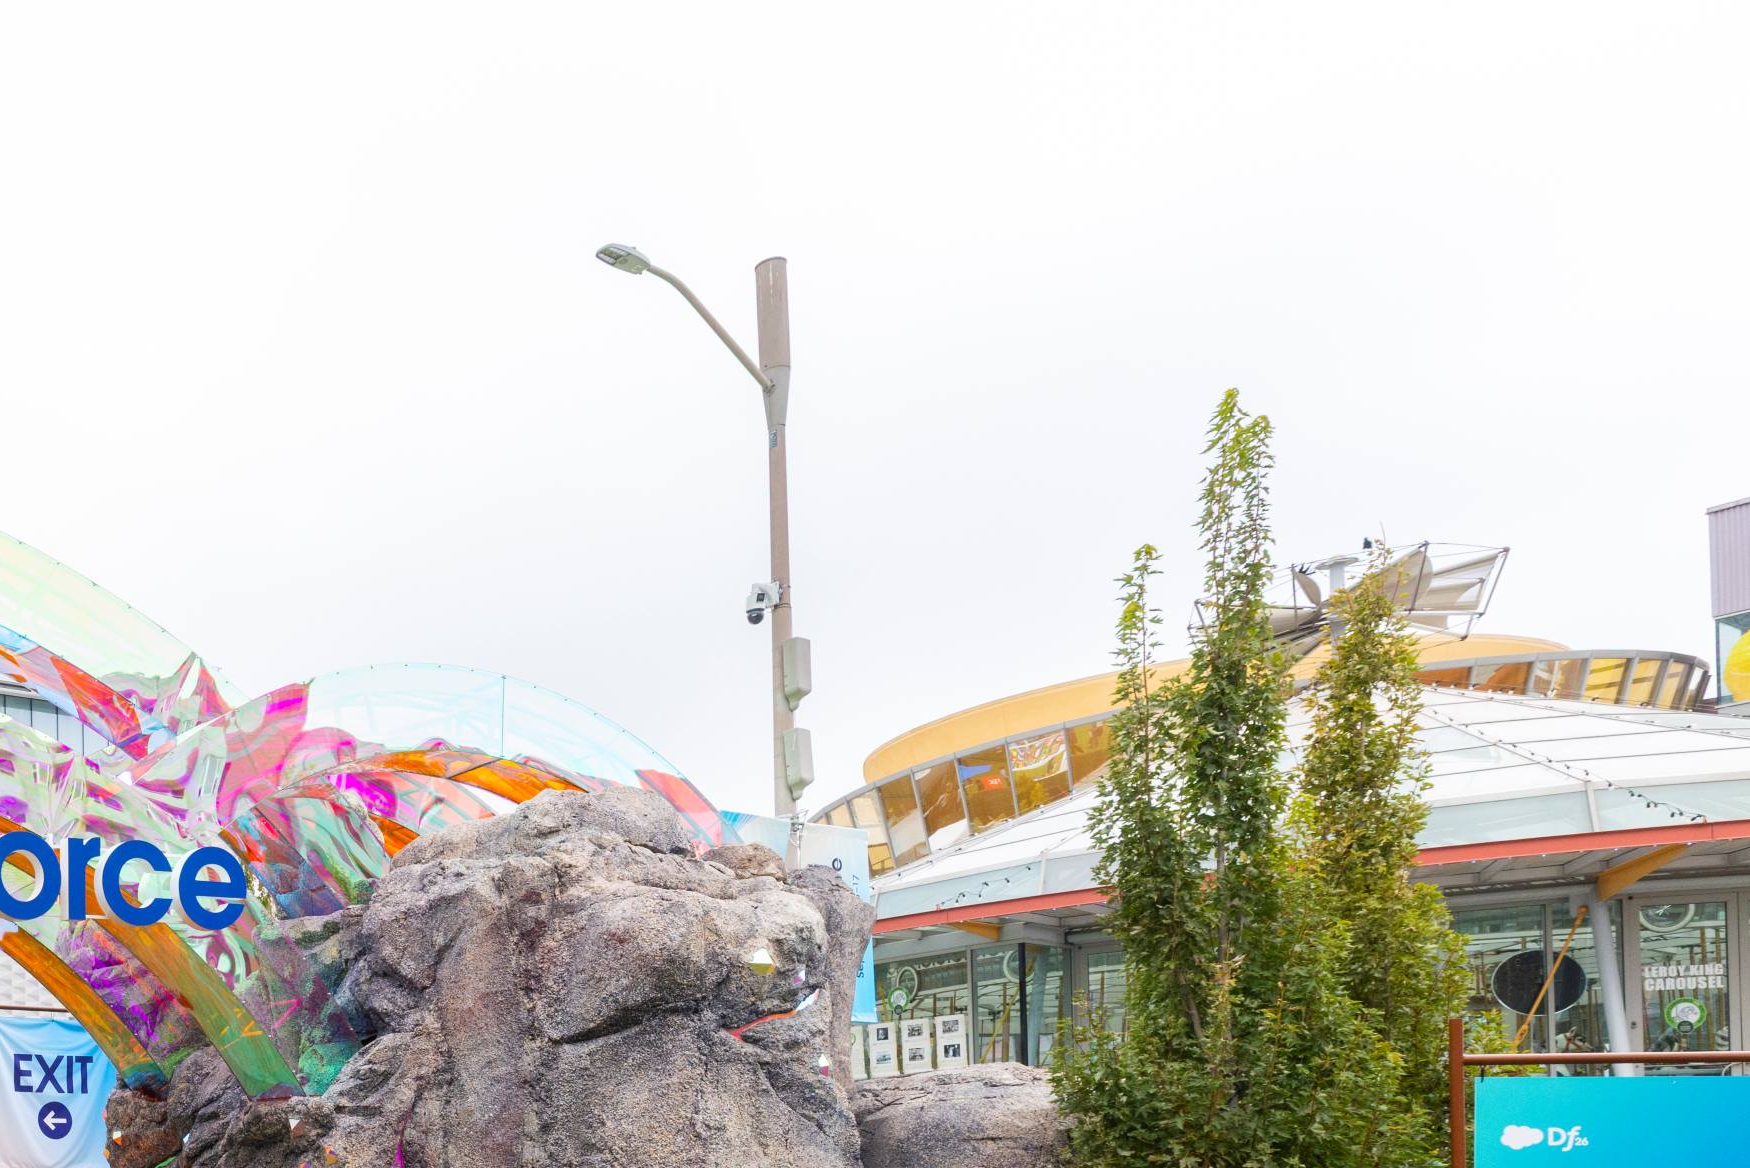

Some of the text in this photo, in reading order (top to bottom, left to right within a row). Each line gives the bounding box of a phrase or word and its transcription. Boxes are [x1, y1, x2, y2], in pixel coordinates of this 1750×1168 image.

[1644, 963, 1724, 978] LEROY KING
[1644, 975, 1724, 992] CAROUSEL
[13, 1053, 94, 1095] EXIT
